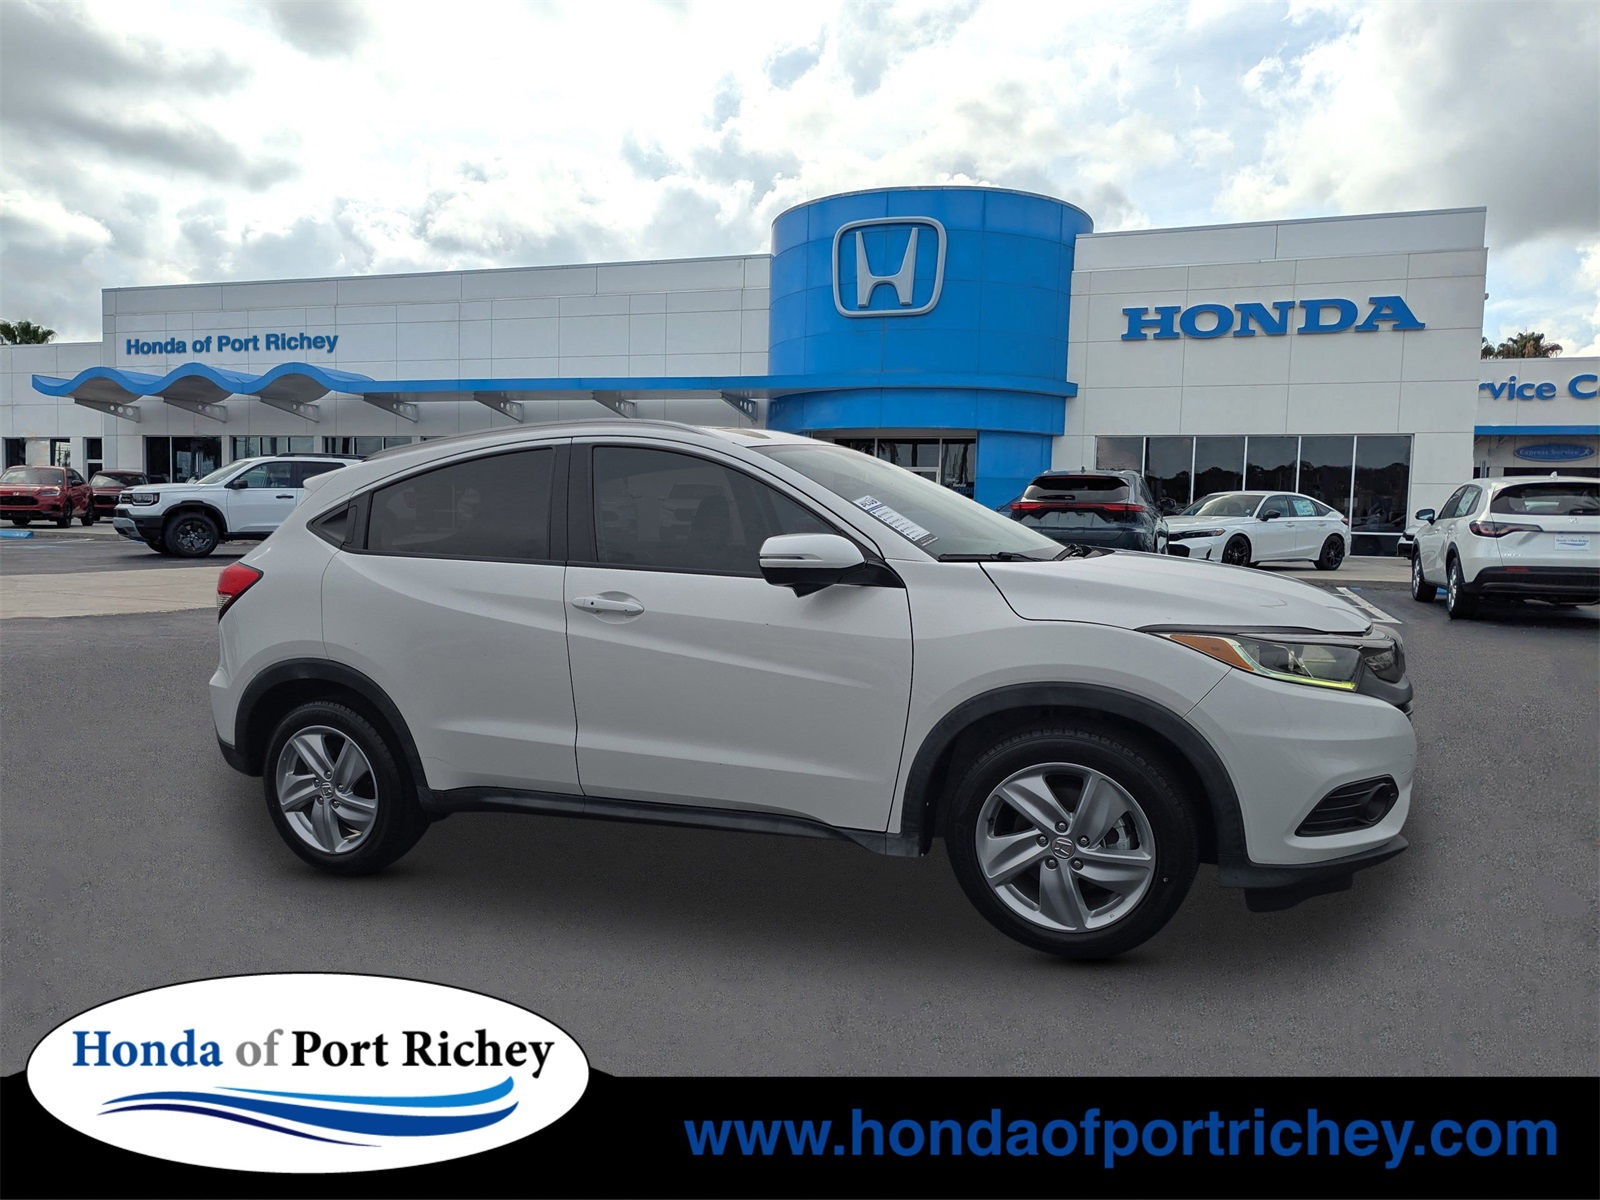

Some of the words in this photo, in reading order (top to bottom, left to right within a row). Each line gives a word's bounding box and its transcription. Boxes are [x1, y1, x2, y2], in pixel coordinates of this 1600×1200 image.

[1121, 295, 1426, 341] HONDA
[126, 337, 187, 355] Honda
[192, 336, 212, 354] of
[217, 335, 260, 353] Port
[265, 332, 339, 354] Richey
[1568, 374, 1600, 400] C
[1519, 448, 1549, 456] Express
[1551, 448, 1579, 456] Service
